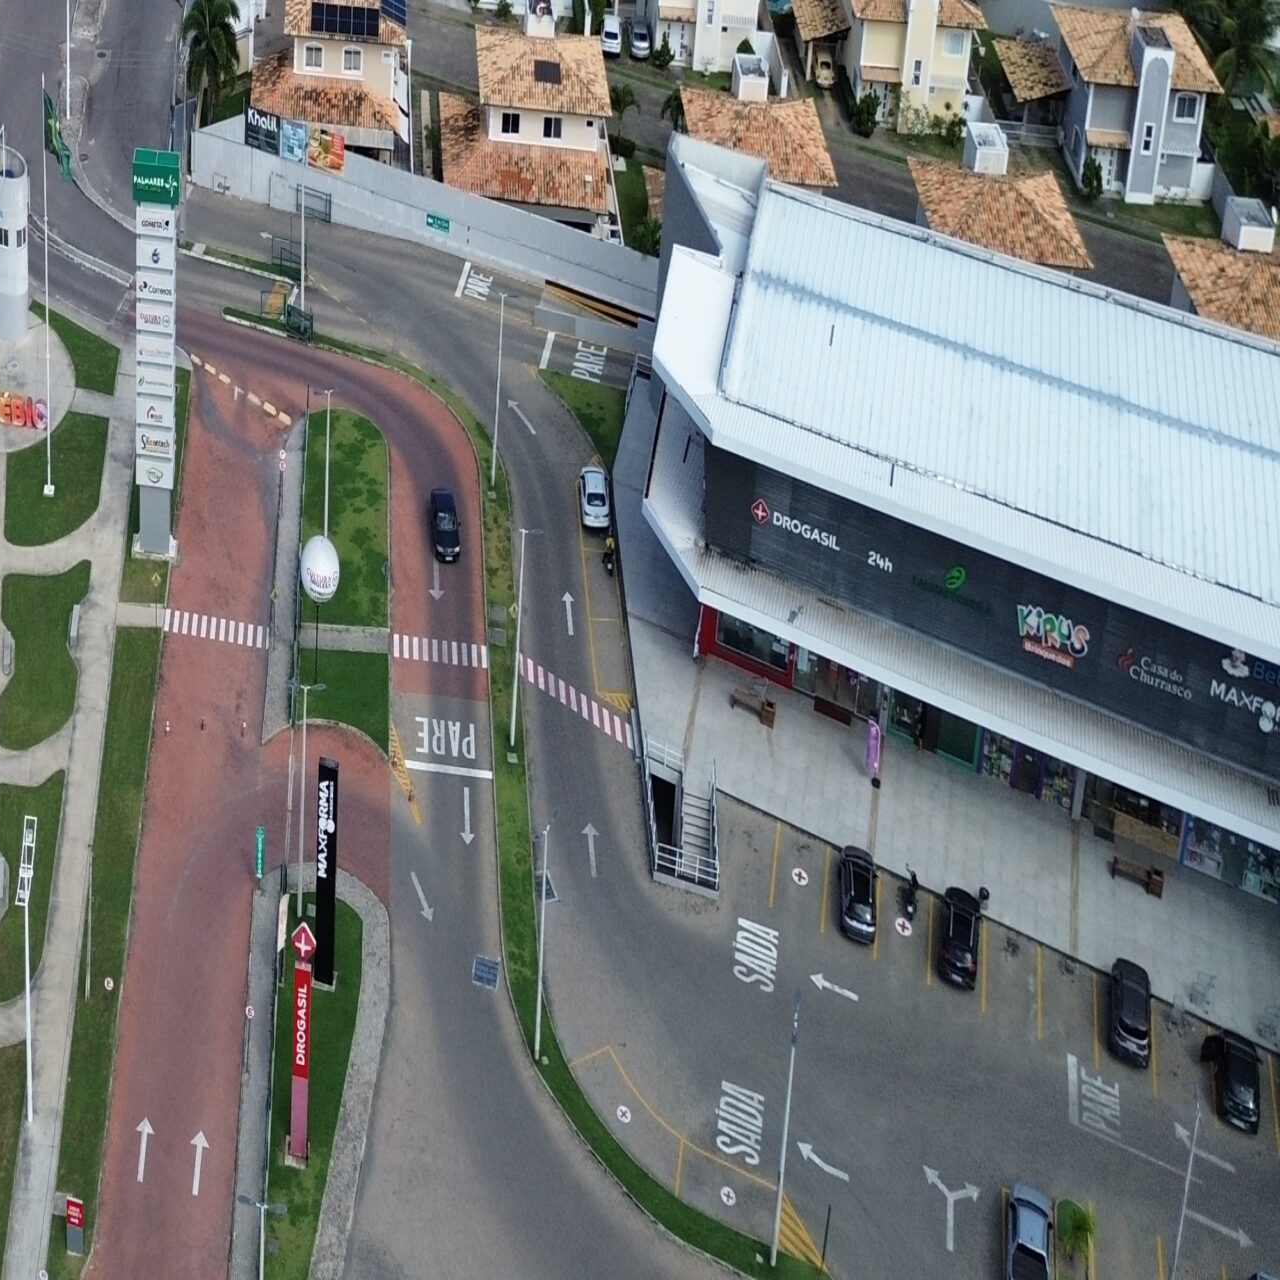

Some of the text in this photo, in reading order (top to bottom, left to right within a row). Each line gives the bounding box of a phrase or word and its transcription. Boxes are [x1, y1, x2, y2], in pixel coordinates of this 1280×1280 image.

[247, 107, 278, 133] Khalil
[133, 175, 164, 187] PALMARES
[464, 269, 494, 302] PARE
[570, 341, 608, 383] PARE
[772, 511, 841, 551] DROGASIL
[867, 550, 893, 573] 24h
[1129, 666, 1193, 701] Churrasco
[1140, 656, 1184, 683] Casa do
[414, 716, 476, 760] PARE
[317, 780, 330, 879] MAXFORMA
[732, 917, 779, 993] SAÍDA
[295, 983, 308, 1066] DROGASIL
[715, 1080, 765, 1166] SAÍDA
[1080, 1066, 1121, 1139] PARE
